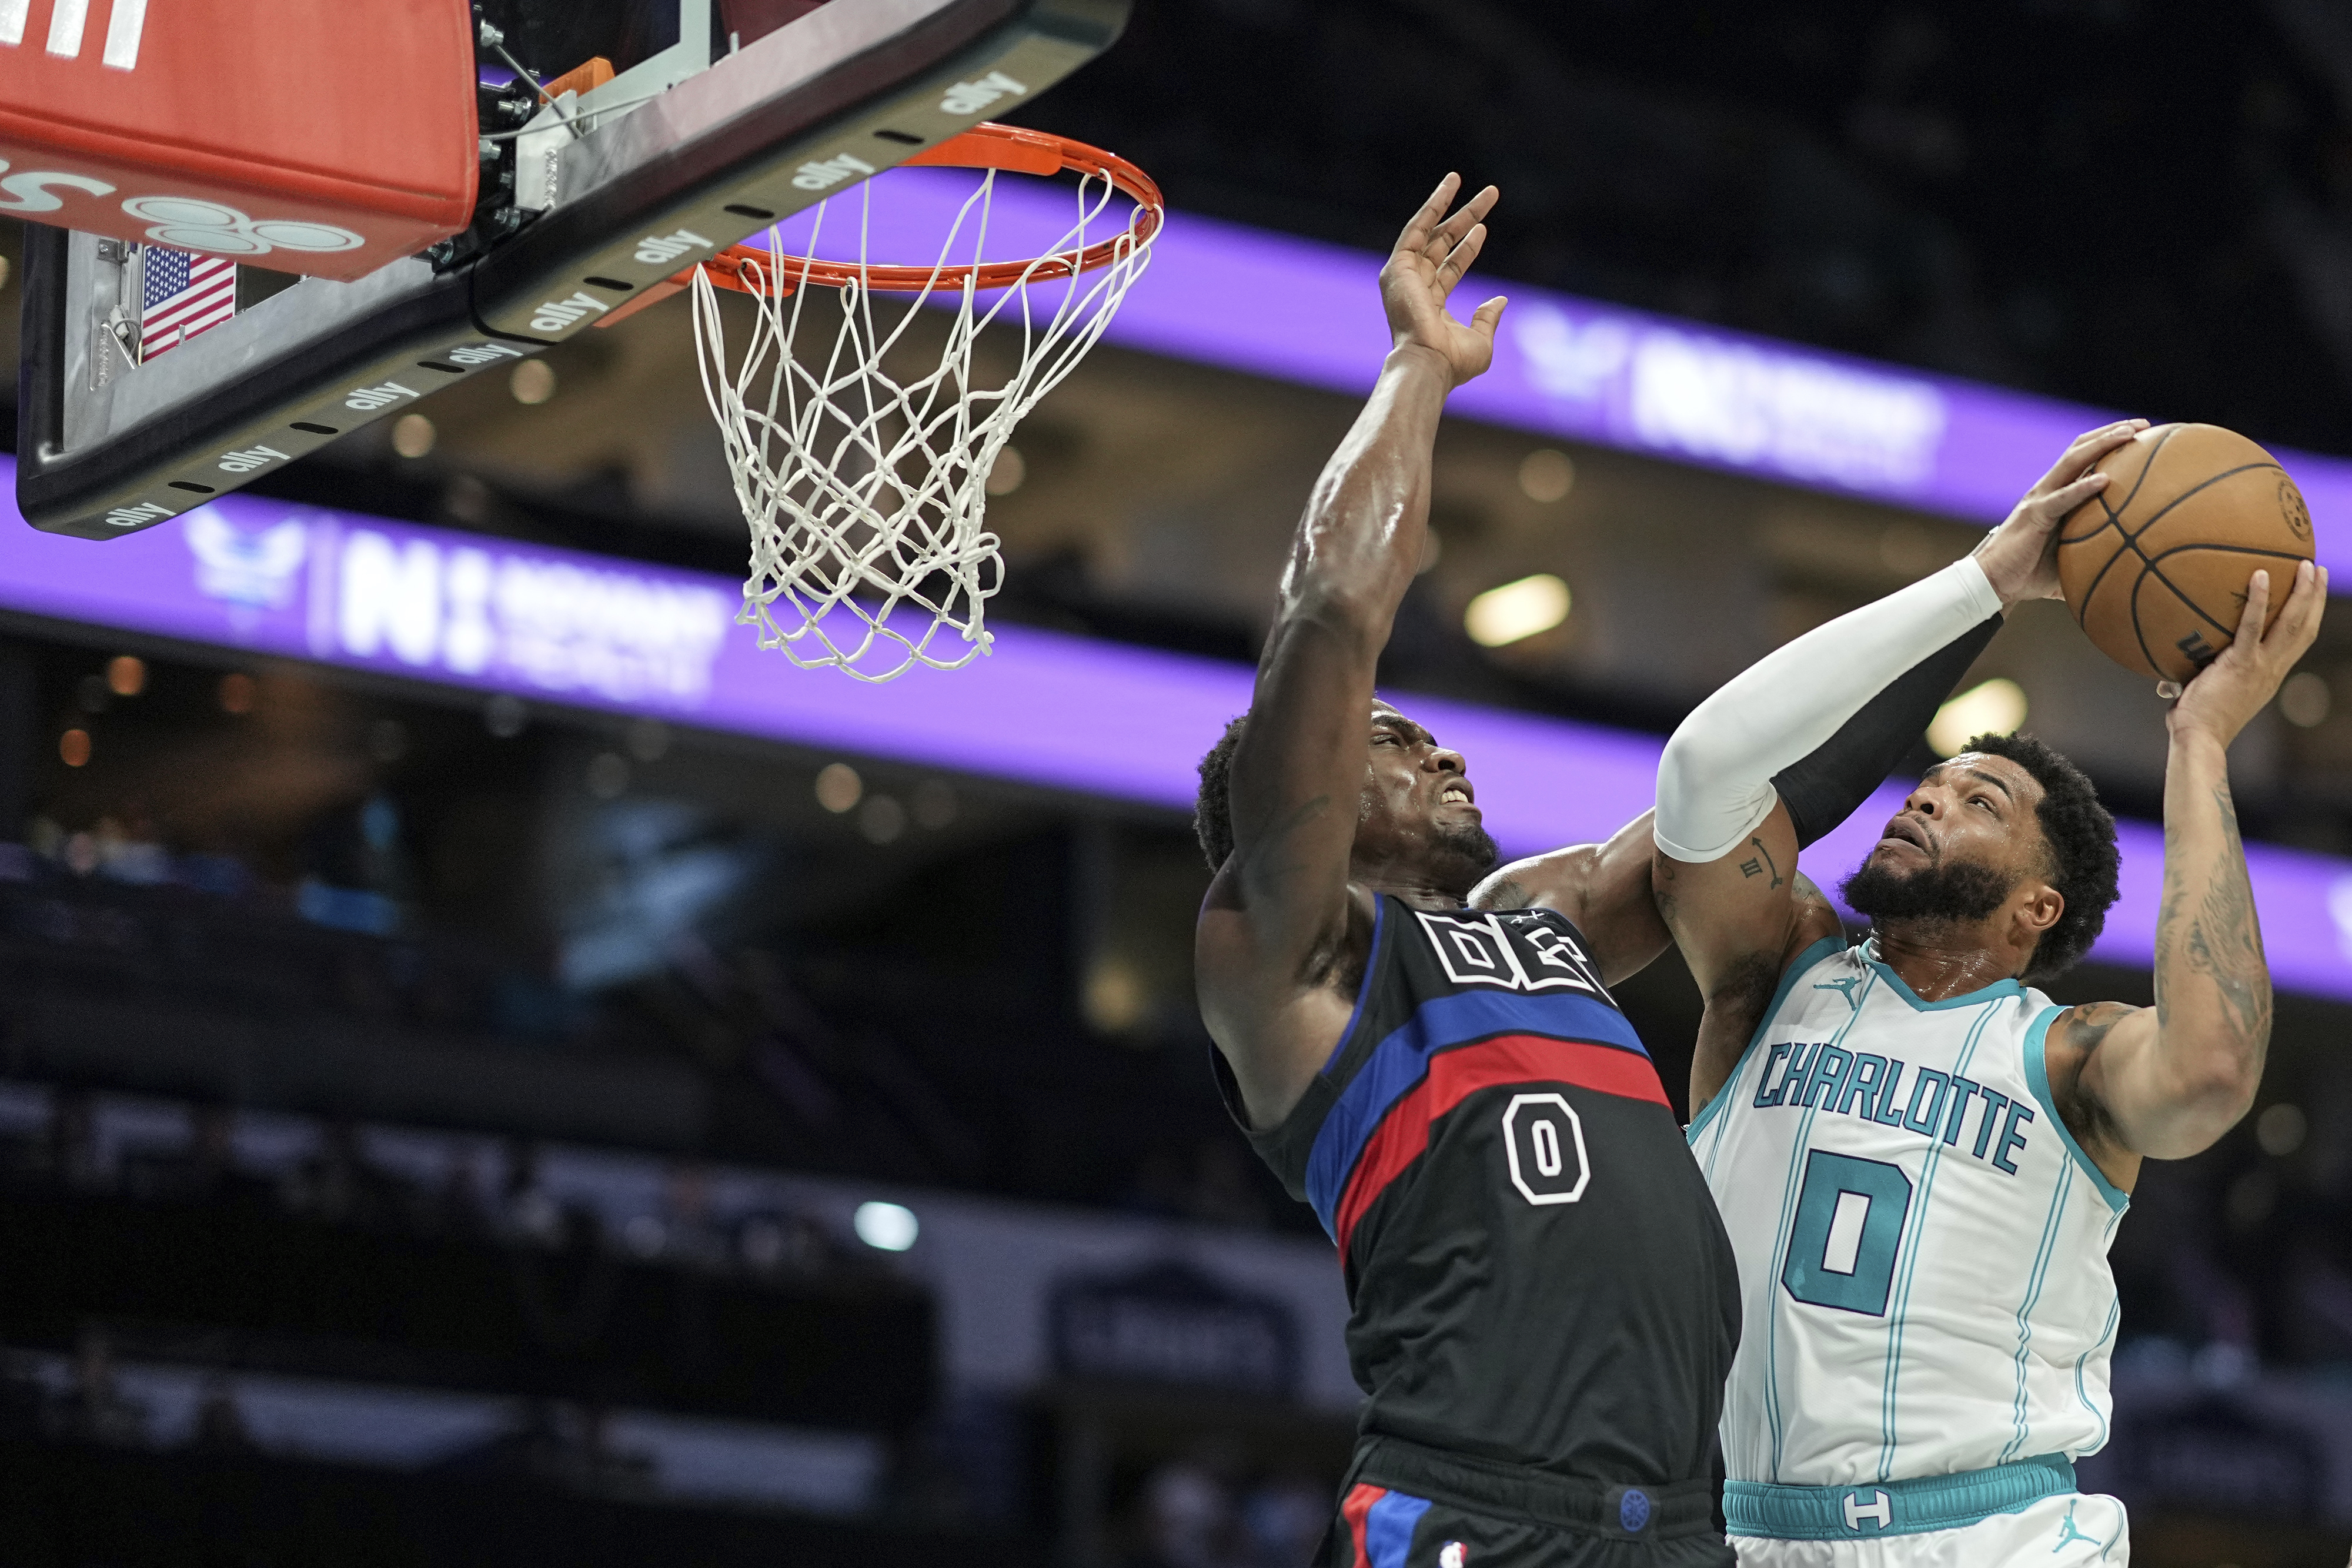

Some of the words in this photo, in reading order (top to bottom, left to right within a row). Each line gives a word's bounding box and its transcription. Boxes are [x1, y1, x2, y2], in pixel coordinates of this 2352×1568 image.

[940, 71, 1028, 115] ally
[791, 152, 876, 190] ally
[633, 229, 714, 265] ally
[530, 290, 609, 333] ally
[449, 343, 524, 365] ally
[345, 381, 421, 411] ally
[218, 444, 291, 473] ally
[105, 502, 177, 527] ally
[1752, 1042, 2035, 1176] CHARLOTTE
[1502, 1093, 1591, 1206] 0
[1781, 1148, 1913, 1318] 0
